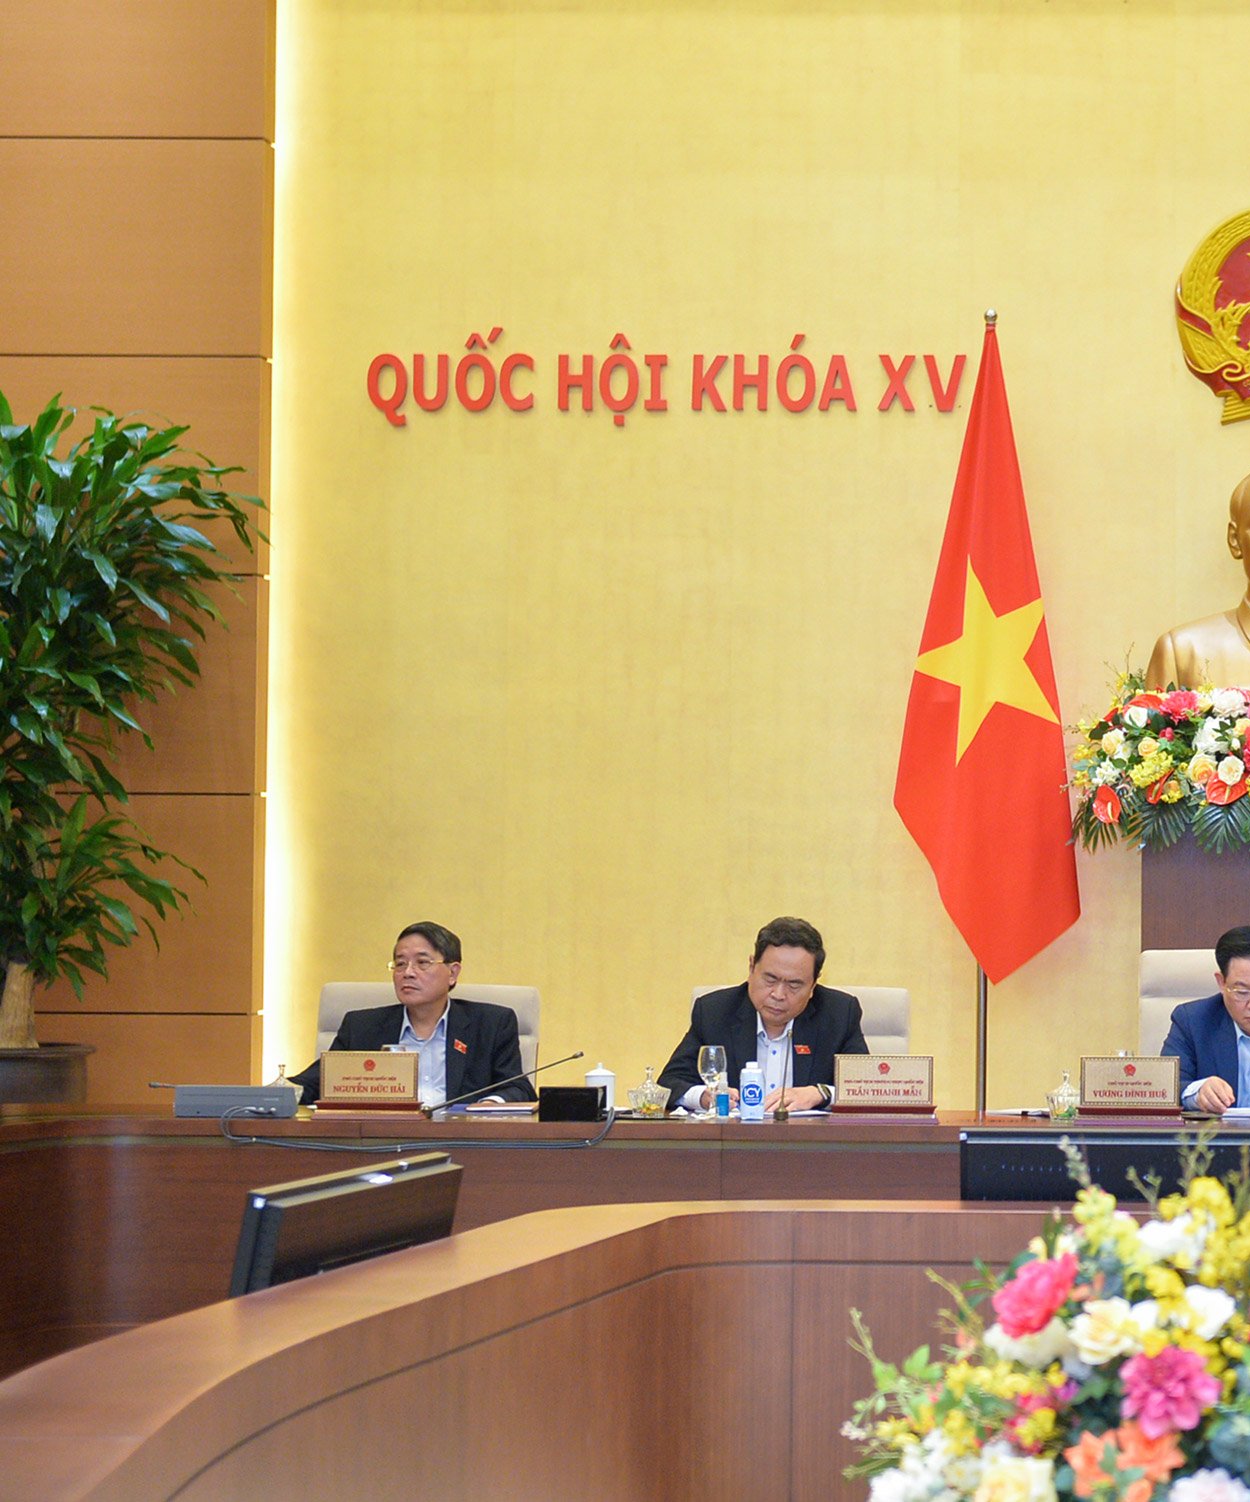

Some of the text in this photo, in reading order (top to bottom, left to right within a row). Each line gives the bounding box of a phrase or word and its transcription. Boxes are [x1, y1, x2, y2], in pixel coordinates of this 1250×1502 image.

[368, 326, 967, 426] QUỐC HỘI KHÓA XV
[744, 1088, 760, 1097] ICY
[871, 1088, 900, 1096] THANH
